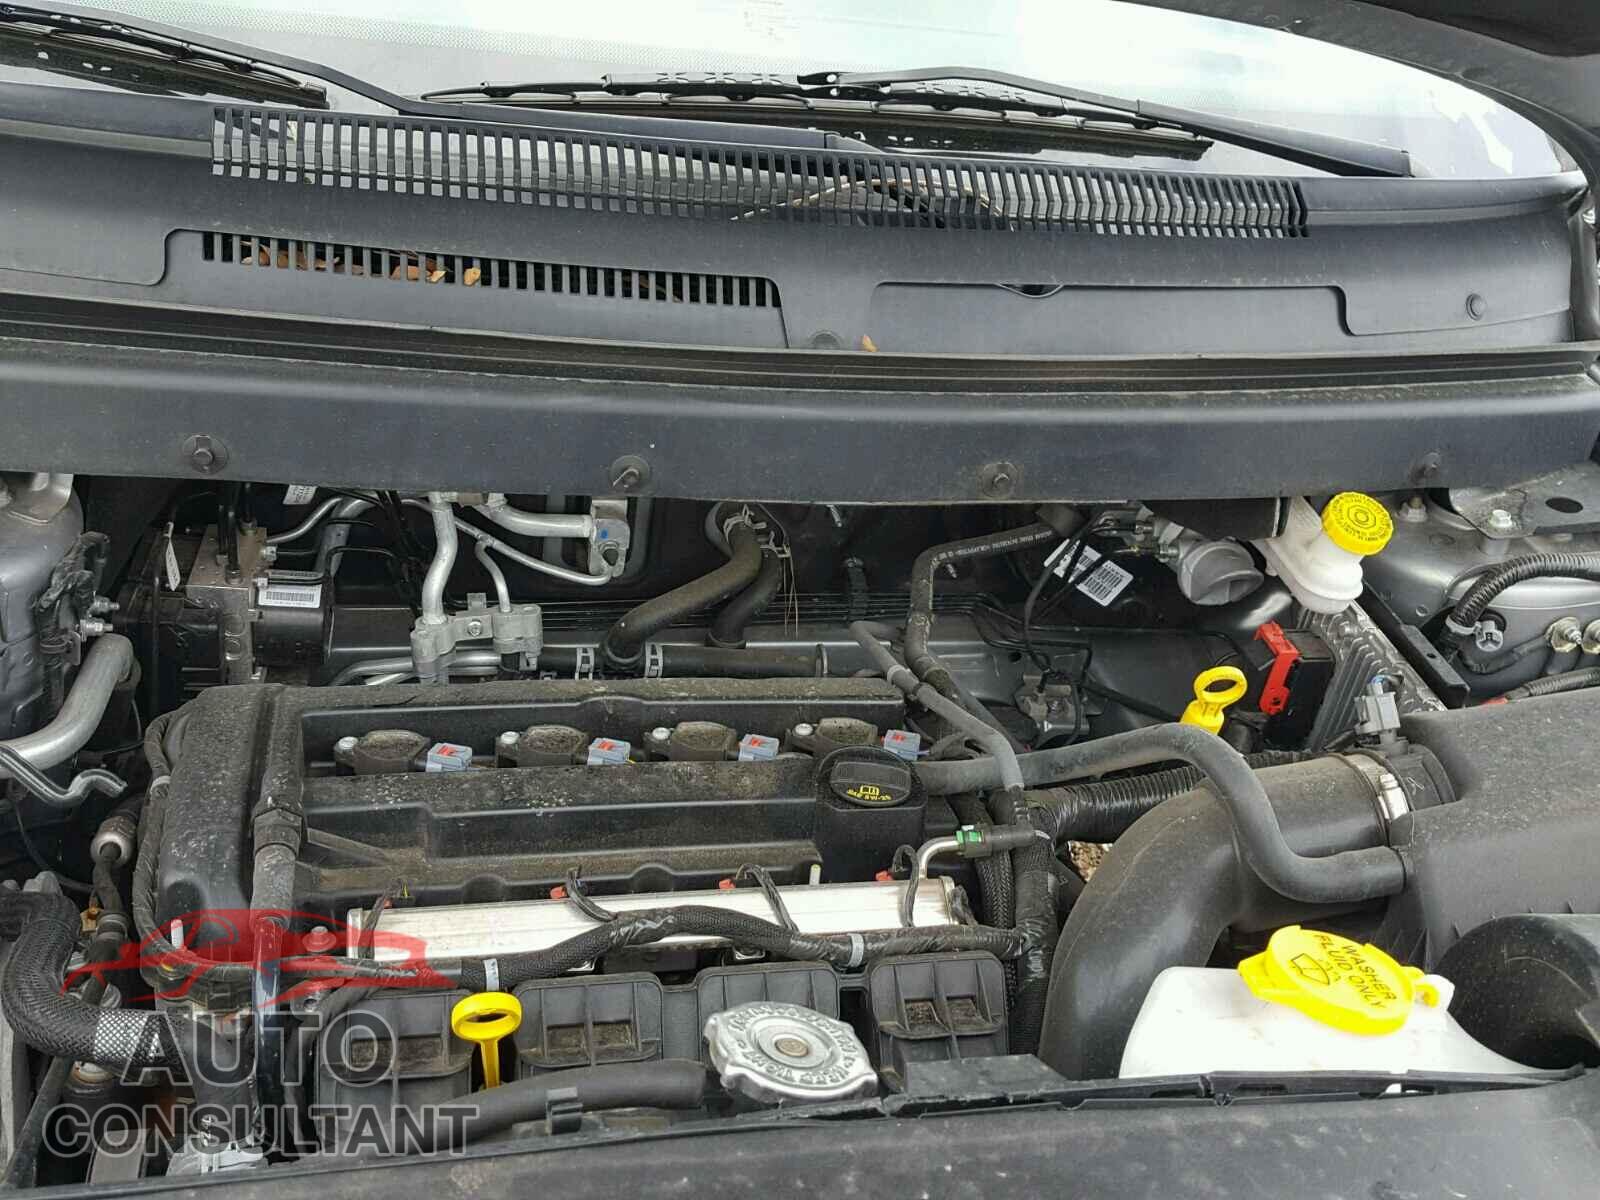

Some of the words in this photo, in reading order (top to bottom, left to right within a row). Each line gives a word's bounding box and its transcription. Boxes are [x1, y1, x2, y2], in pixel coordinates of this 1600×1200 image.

[1314, 933, 1351, 972] FLUID
[1349, 972, 1387, 1009] ONLY
[1341, 944, 1397, 1000] WASHER
